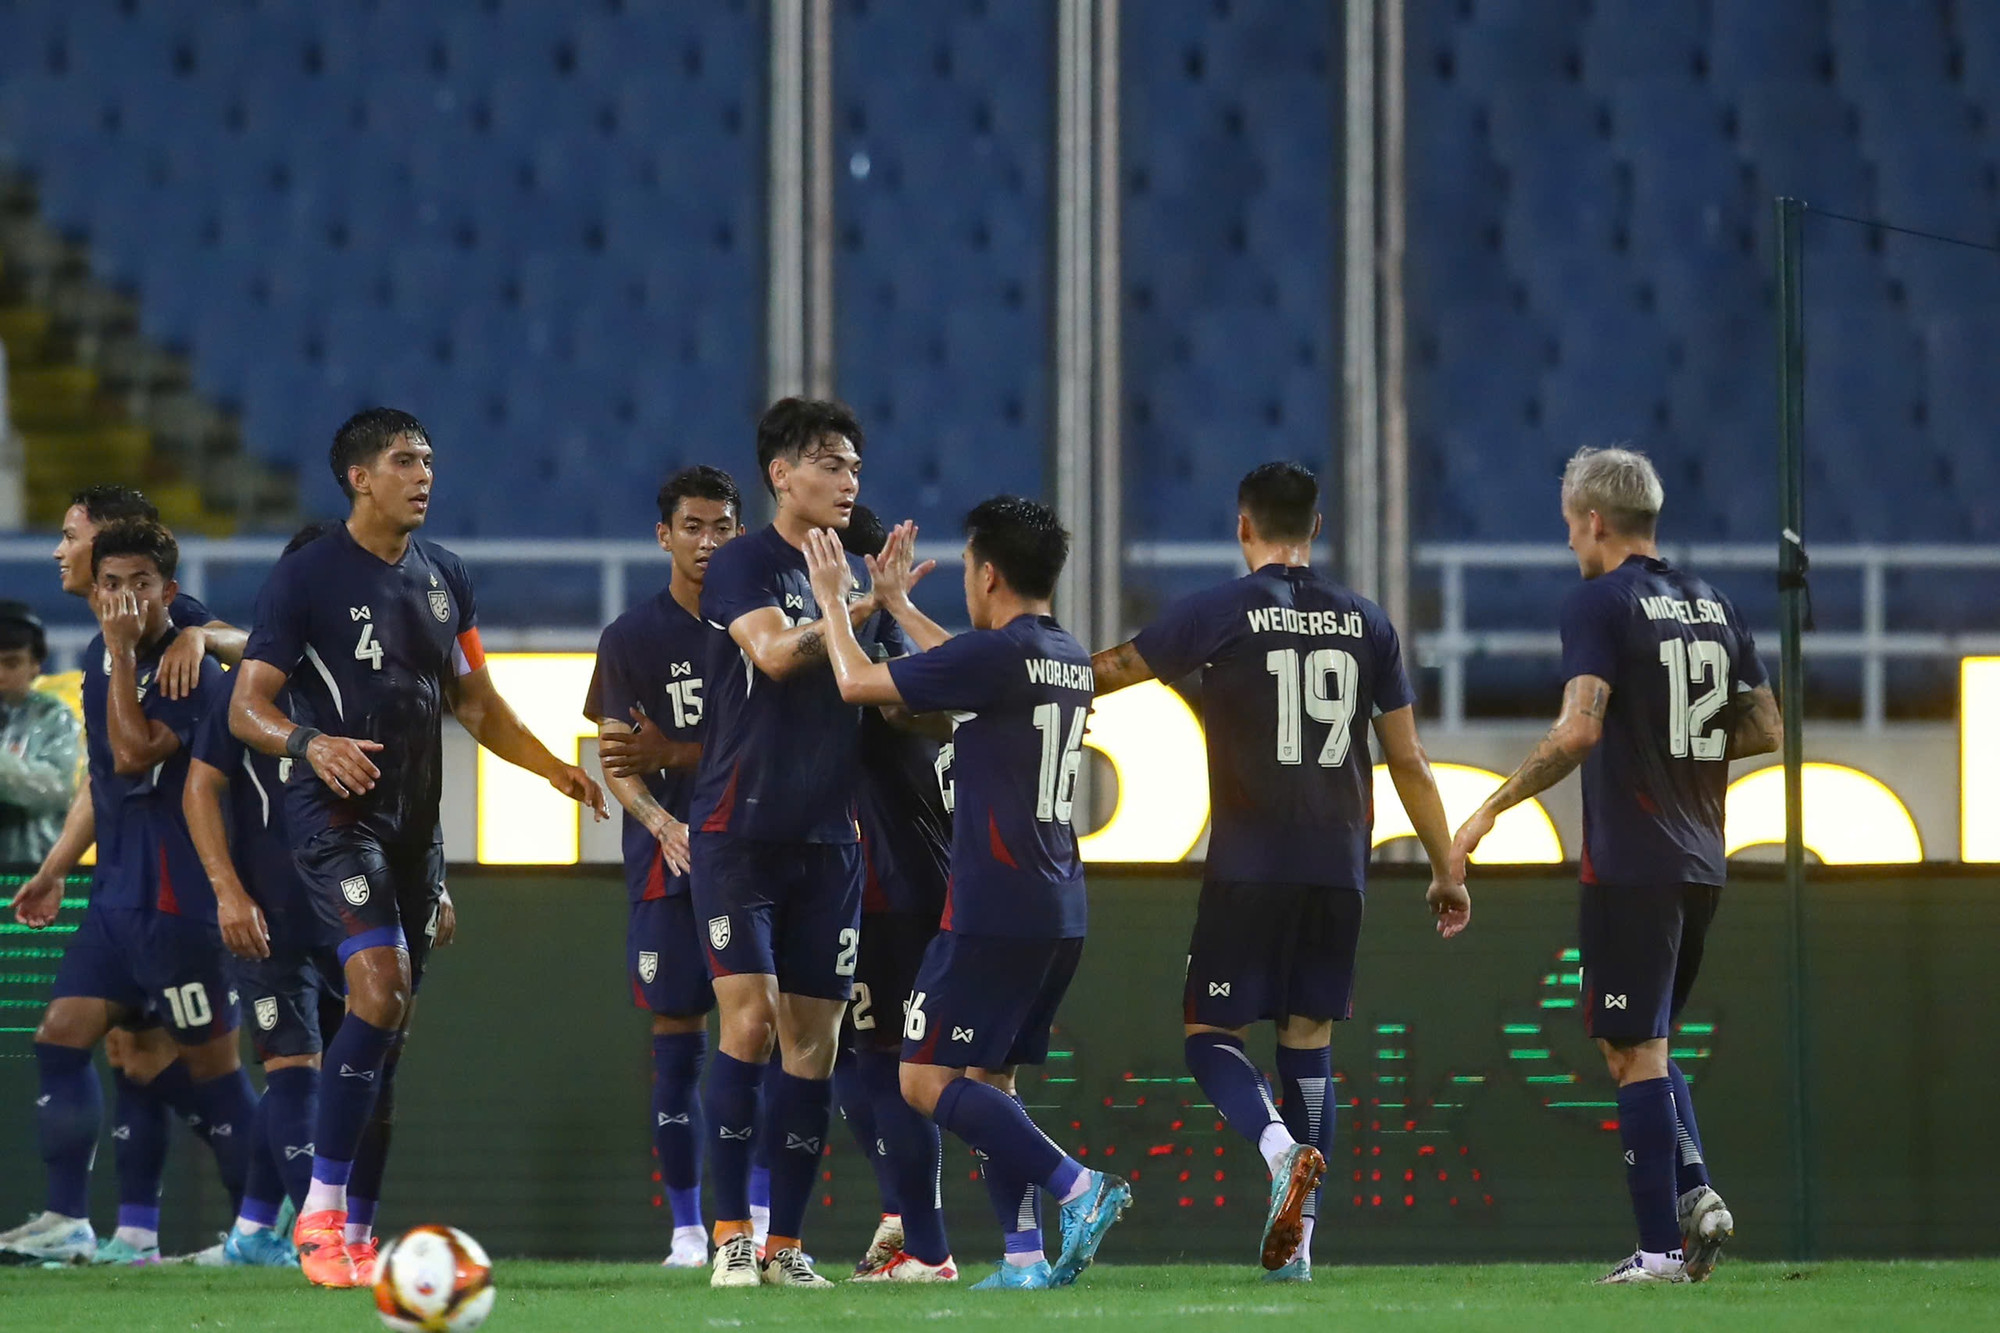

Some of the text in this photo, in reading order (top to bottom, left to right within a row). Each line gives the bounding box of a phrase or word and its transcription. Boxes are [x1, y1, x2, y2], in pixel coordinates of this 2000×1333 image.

[354, 623, 384, 670] 4
[1247, 607, 1363, 638] WEIDERSJÖ
[665, 678, 703, 728] 15
[1266, 648, 1359, 768] 19
[1659, 637, 1731, 762] 12
[1032, 702, 1087, 825] 16
[835, 927, 859, 976] 2
[164, 982, 213, 1029] 10
